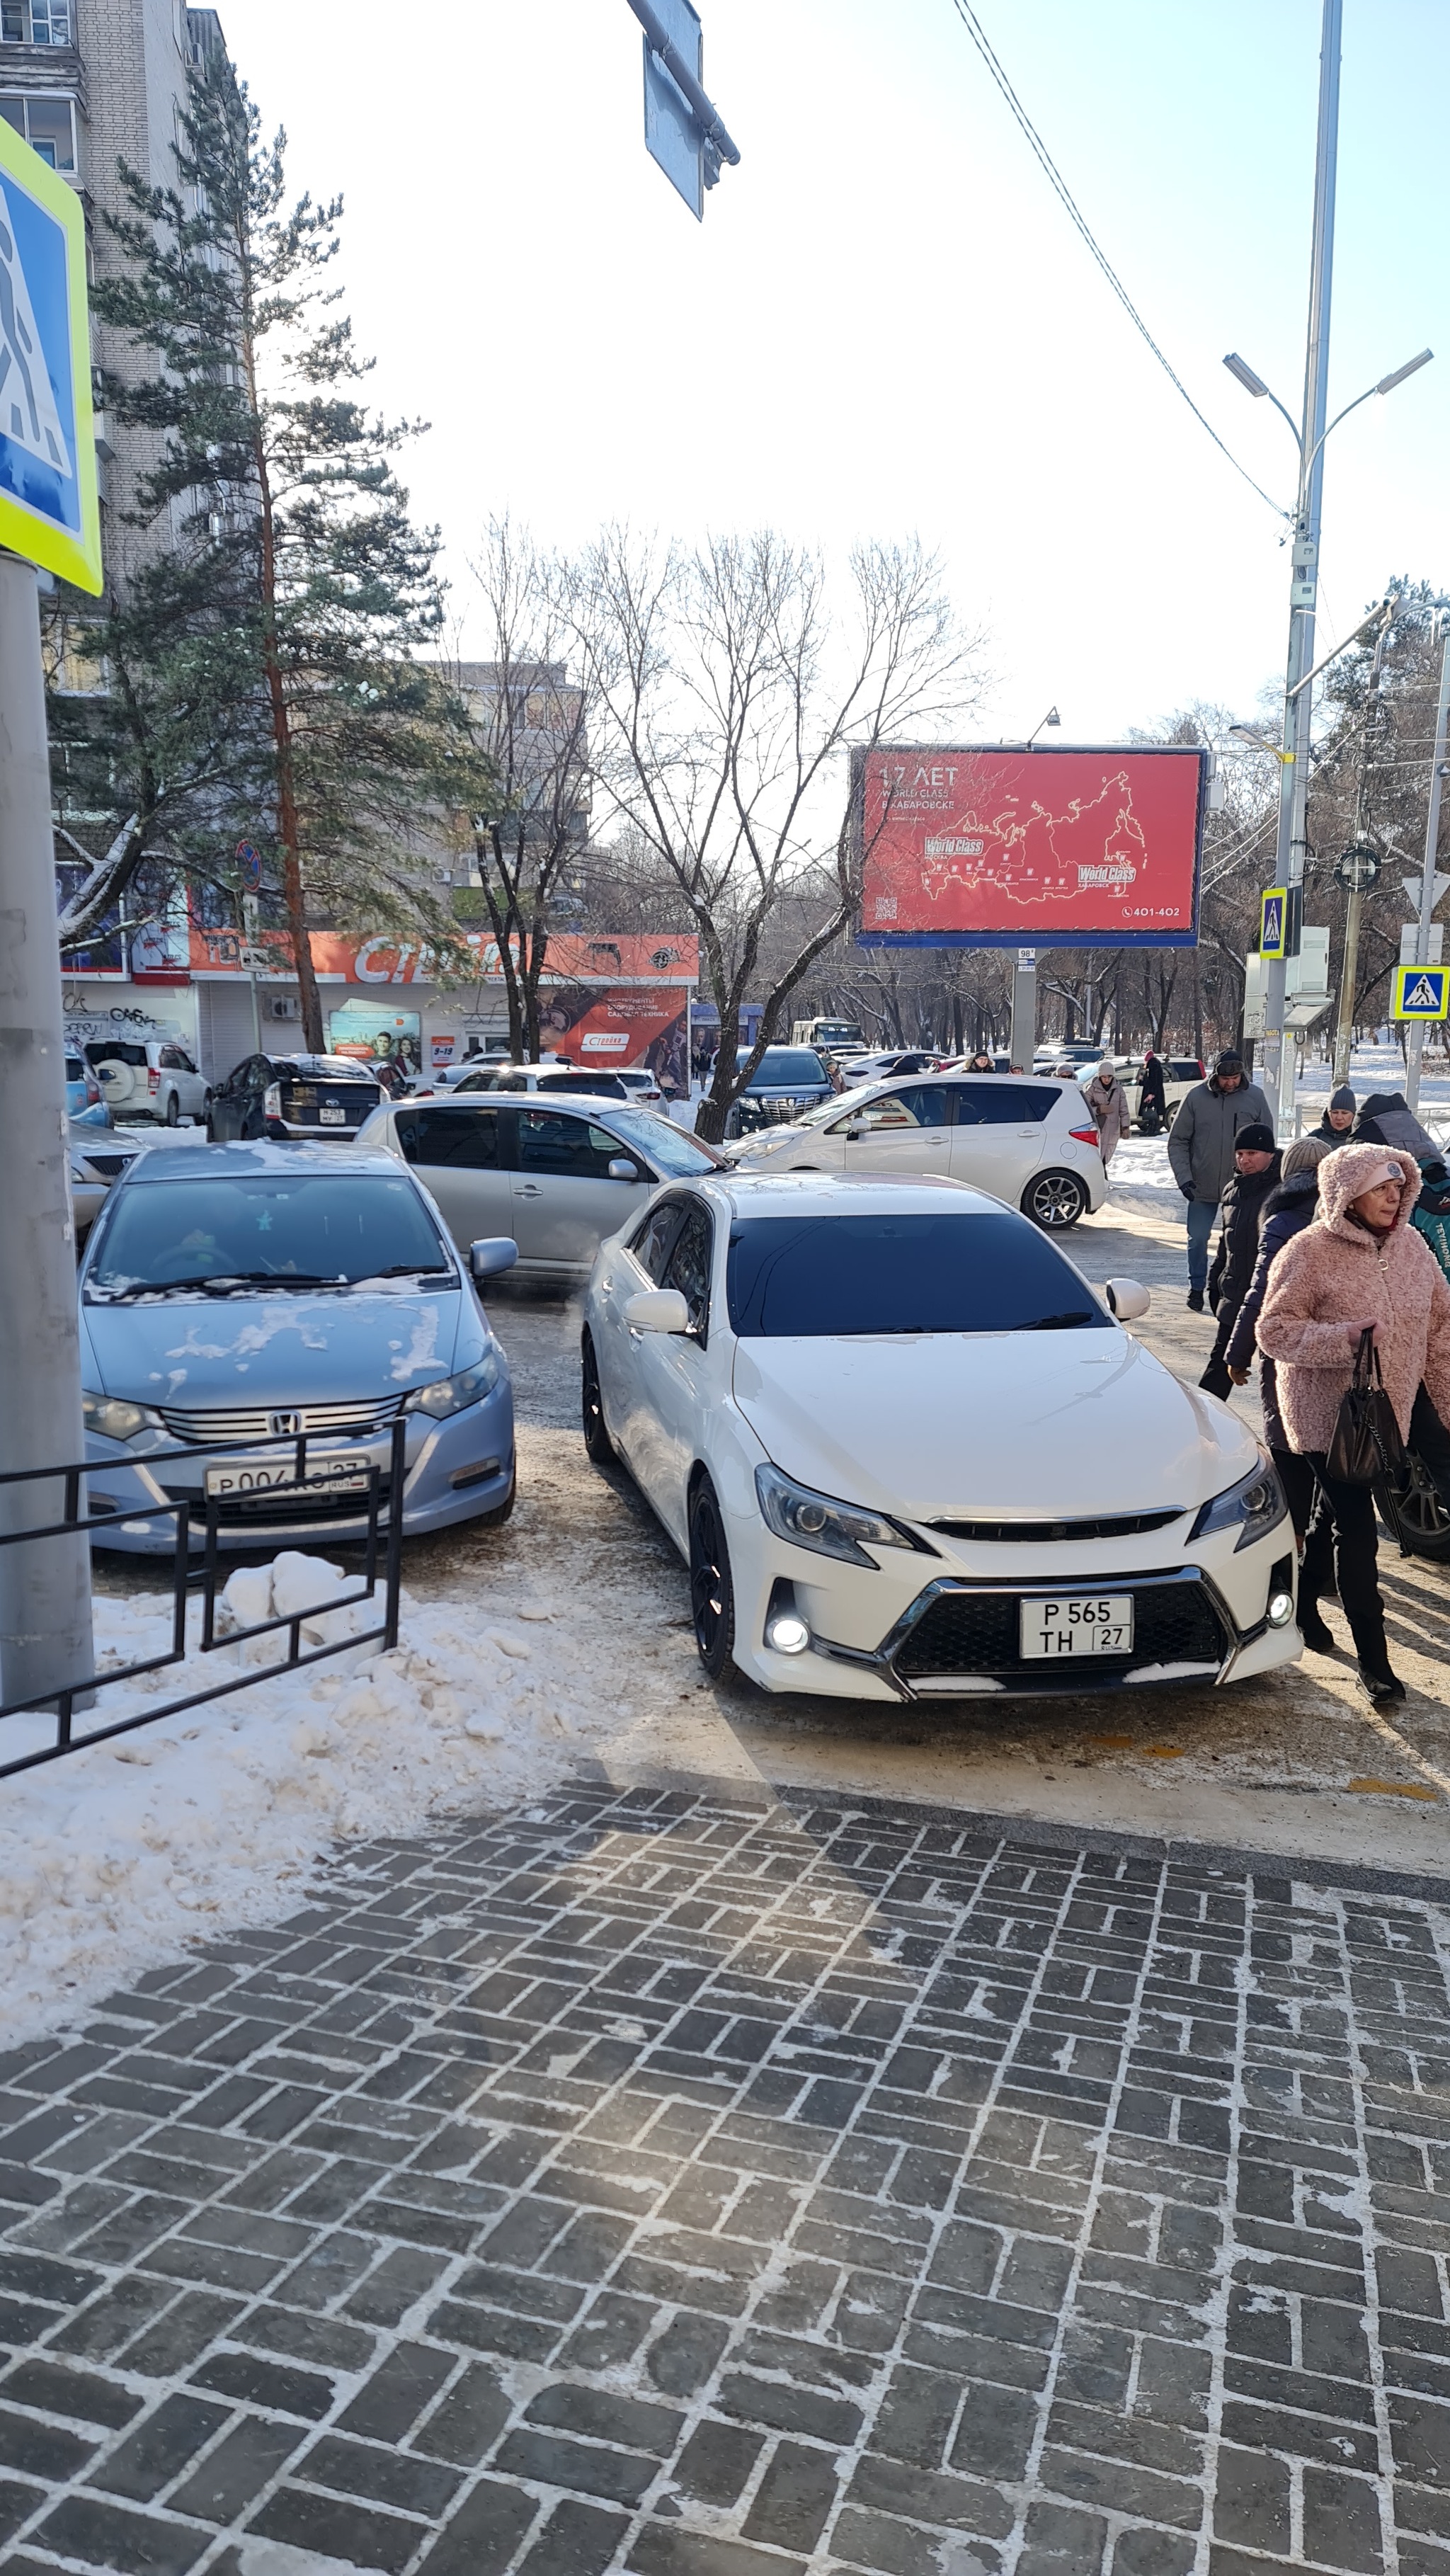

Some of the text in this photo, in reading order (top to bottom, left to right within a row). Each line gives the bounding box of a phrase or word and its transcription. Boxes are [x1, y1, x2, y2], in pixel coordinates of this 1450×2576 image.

[879, 766, 959, 787] 17 ЛЕТ
[920, 789, 949, 797] CLASS
[881, 800, 955, 809] В ХАБАРОВСКЕ
[927, 838, 981, 853] World Class
[1080, 866, 1135, 882] World Class
[1134, 907, 1180, 916] 401-402
[434, 1047, 453, 1056] 9-19
[1045, 1602, 1111, 1625] Р 565
[1039, 1630, 1073, 1653] ТН
[1101, 1628, 1123, 1645] 27
